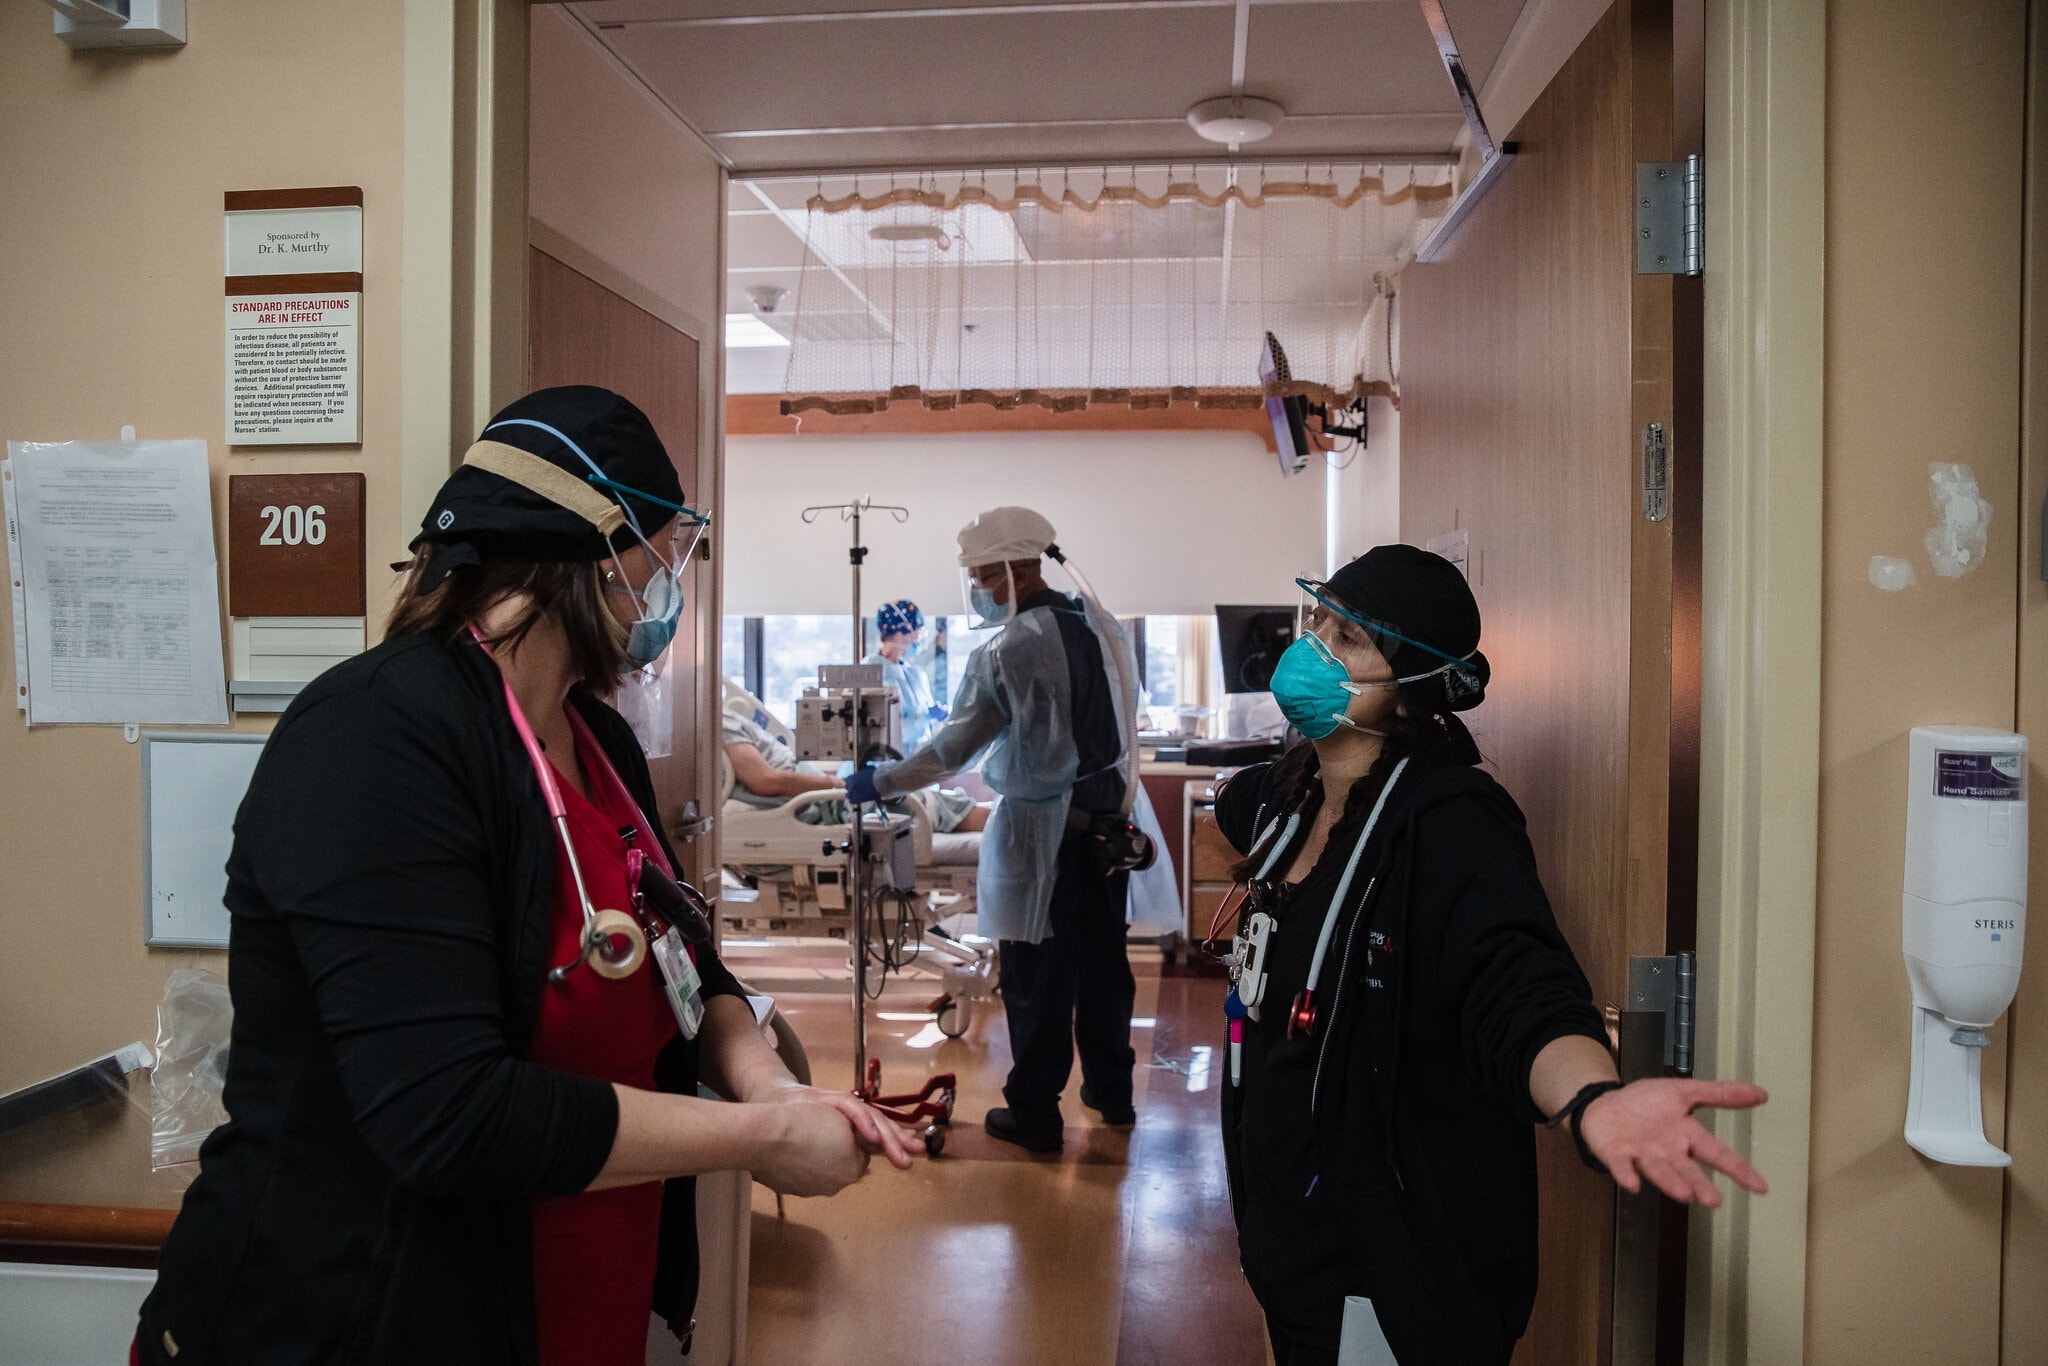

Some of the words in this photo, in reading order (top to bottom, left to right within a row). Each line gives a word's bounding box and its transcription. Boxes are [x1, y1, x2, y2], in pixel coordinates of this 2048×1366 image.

[267, 231, 309, 242] Sponsored
[311, 231, 320, 240] by
[258, 244, 274, 254] Dr.
[277, 243, 288, 253] K.
[291, 242, 330, 254] Murthy
[232, 301, 282, 313] STANDARD
[285, 300, 350, 311] PRECAUTIONS
[258, 313, 276, 324] ARE
[278, 313, 289, 323] IN
[291, 312, 323, 322] EFFECT
[300, 332, 331, 340] possibility
[285, 349, 317, 358] potentially
[296, 383, 332, 392] precautions
[260, 505, 326, 546] 206
[1943, 786, 1967, 795] Hand
[1969, 787, 2011, 796] Sanitizer
[1974, 919, 2014, 929] STERIS
